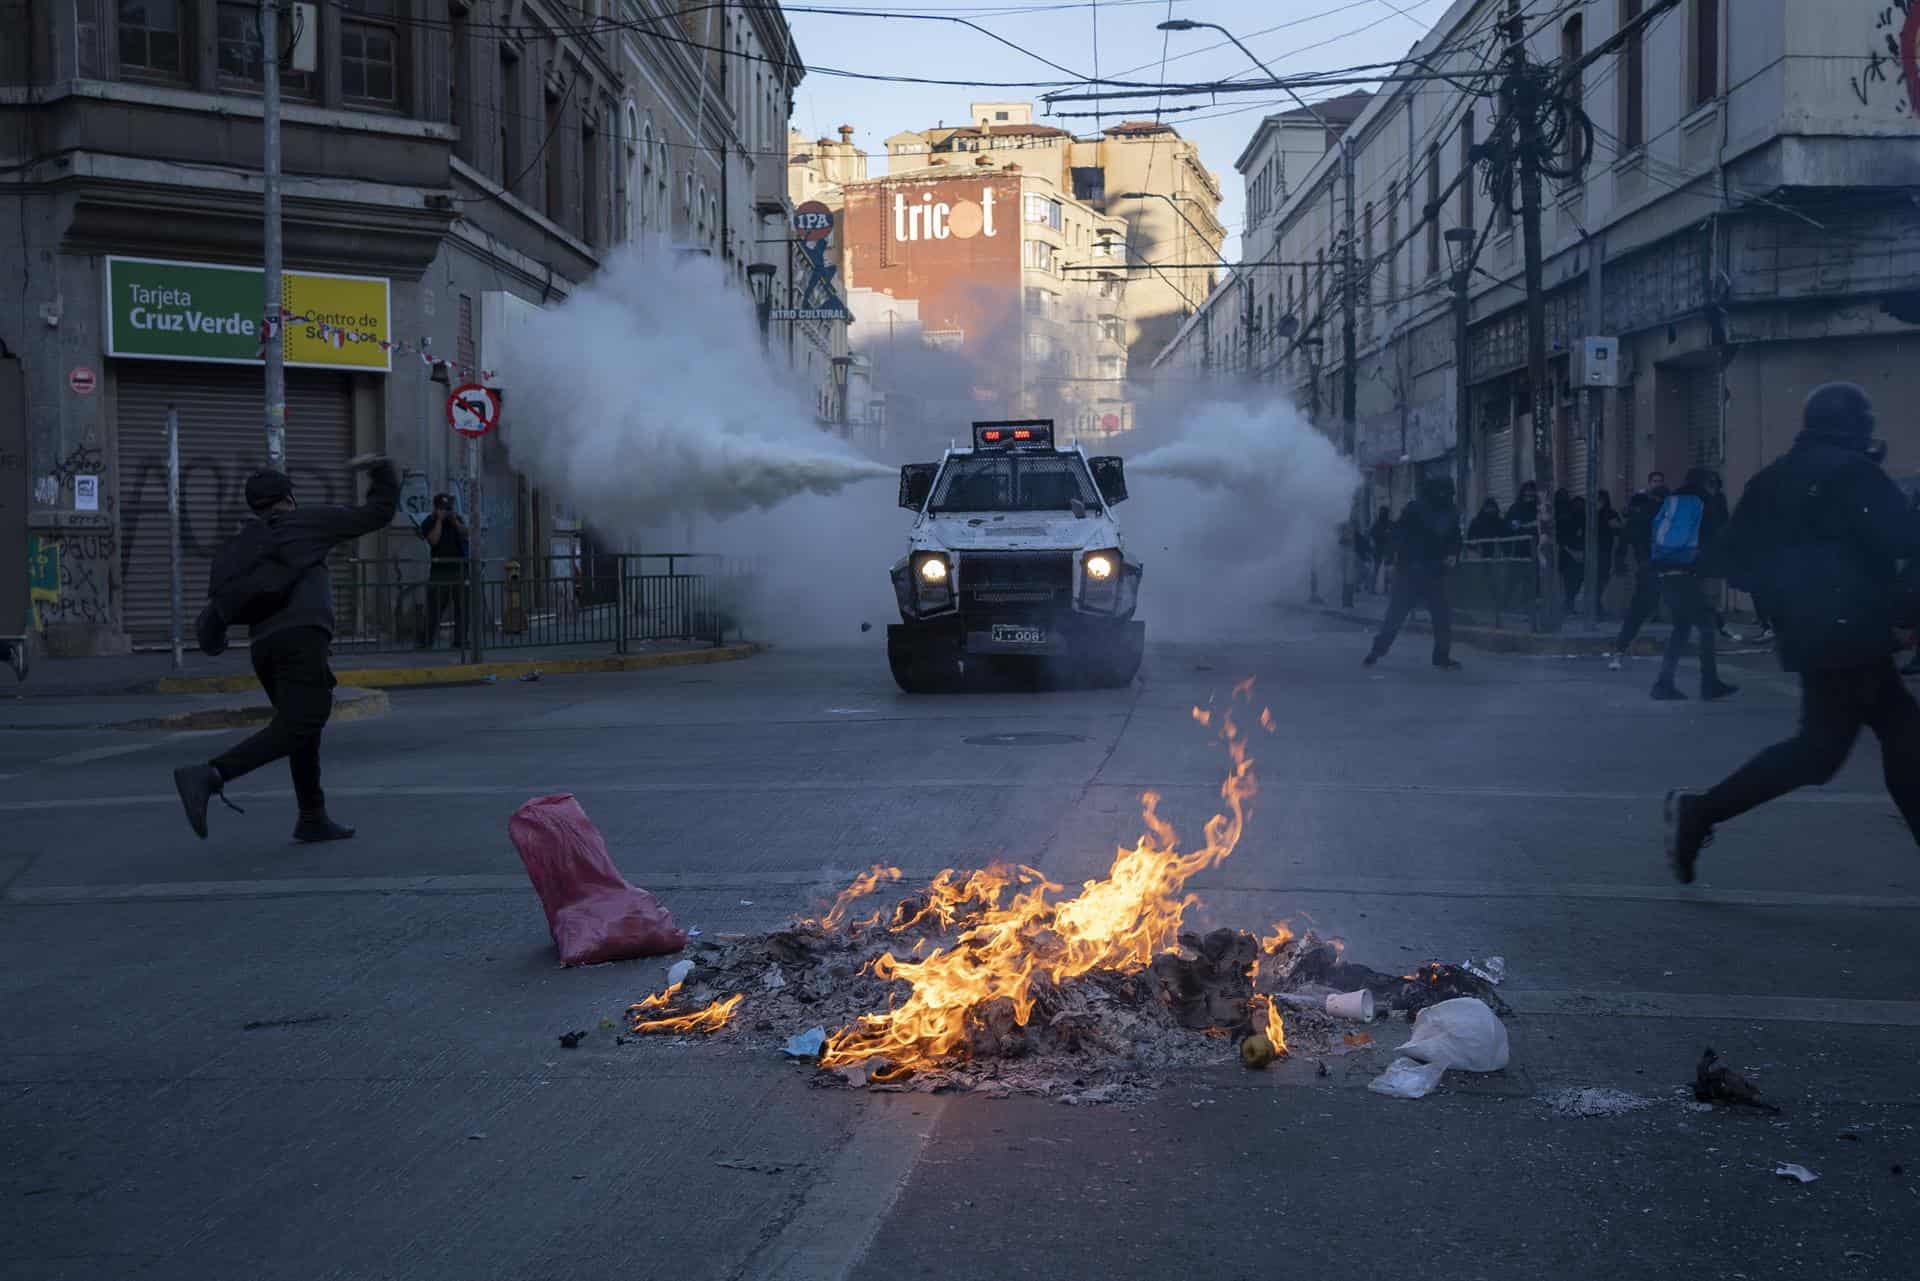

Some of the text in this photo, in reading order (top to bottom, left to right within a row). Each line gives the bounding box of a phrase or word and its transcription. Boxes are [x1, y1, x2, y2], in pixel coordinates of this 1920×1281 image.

[893, 187, 998, 242] tricot
[129, 283, 192, 310] Tarjeta
[304, 309, 377, 328] Centro de
[799, 309, 846, 320] CULTURAL
